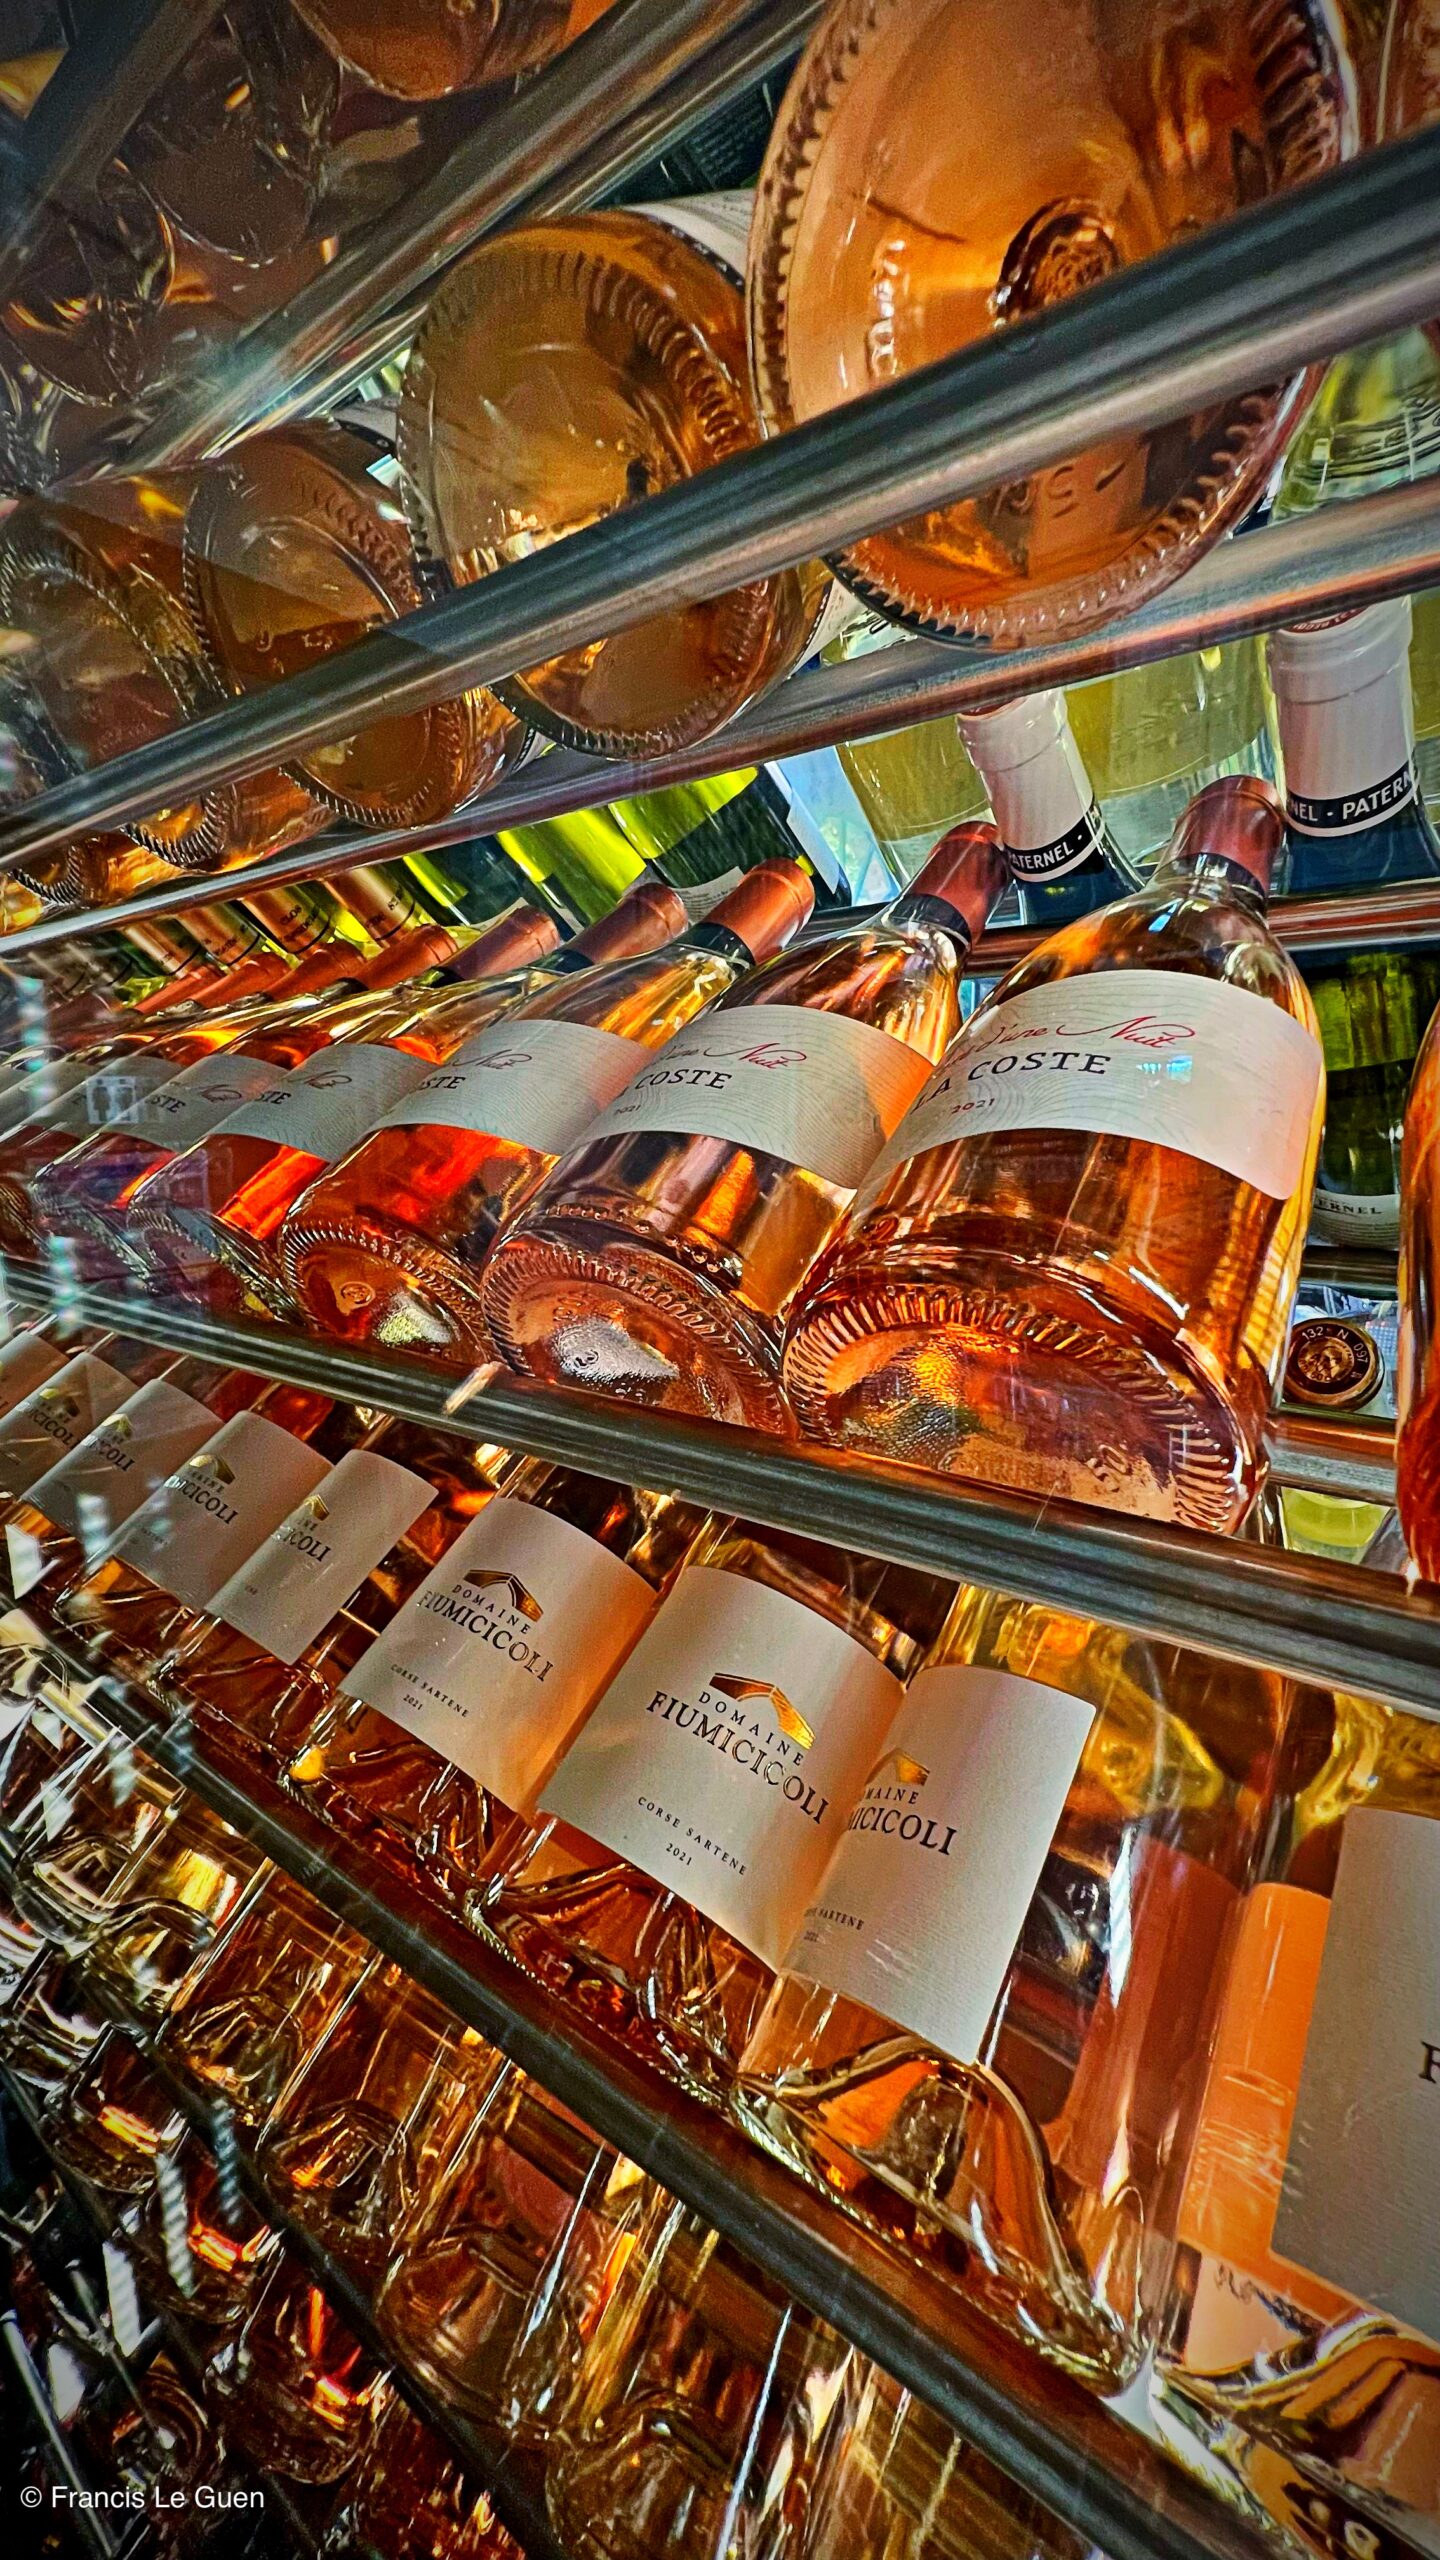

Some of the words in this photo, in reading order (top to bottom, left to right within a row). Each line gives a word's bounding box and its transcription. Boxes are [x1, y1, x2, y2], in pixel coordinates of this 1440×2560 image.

[1008, 841, 1074, 869] ATERNEL
[1056, 1015, 1196, 1048] Nuit
[703, 1042, 807, 1069] Nuit
[967, 1052, 1112, 1082] COSTE
[635, 1068, 733, 1090] COSTE
[951, 1098, 995, 1115] 2021
[1301, 1326, 1324, 1341] 132
[1353, 1342, 1369, 1364] 097
[452, 1584, 531, 1635] DOMAINE
[417, 1590, 554, 1683] FIUMICICOLI
[390, 1664, 419, 1683] CORSE
[421, 1682, 469, 1717] SARTENE
[403, 1694, 423, 1710] 2021
[698, 1691, 804, 1767] DOMAINE
[646, 1690, 829, 1825] FIUMICICOLI
[638, 1796, 680, 1829] CORSE
[686, 1827, 747, 1876] SARTENE
[665, 1842, 692, 1867] 2021
